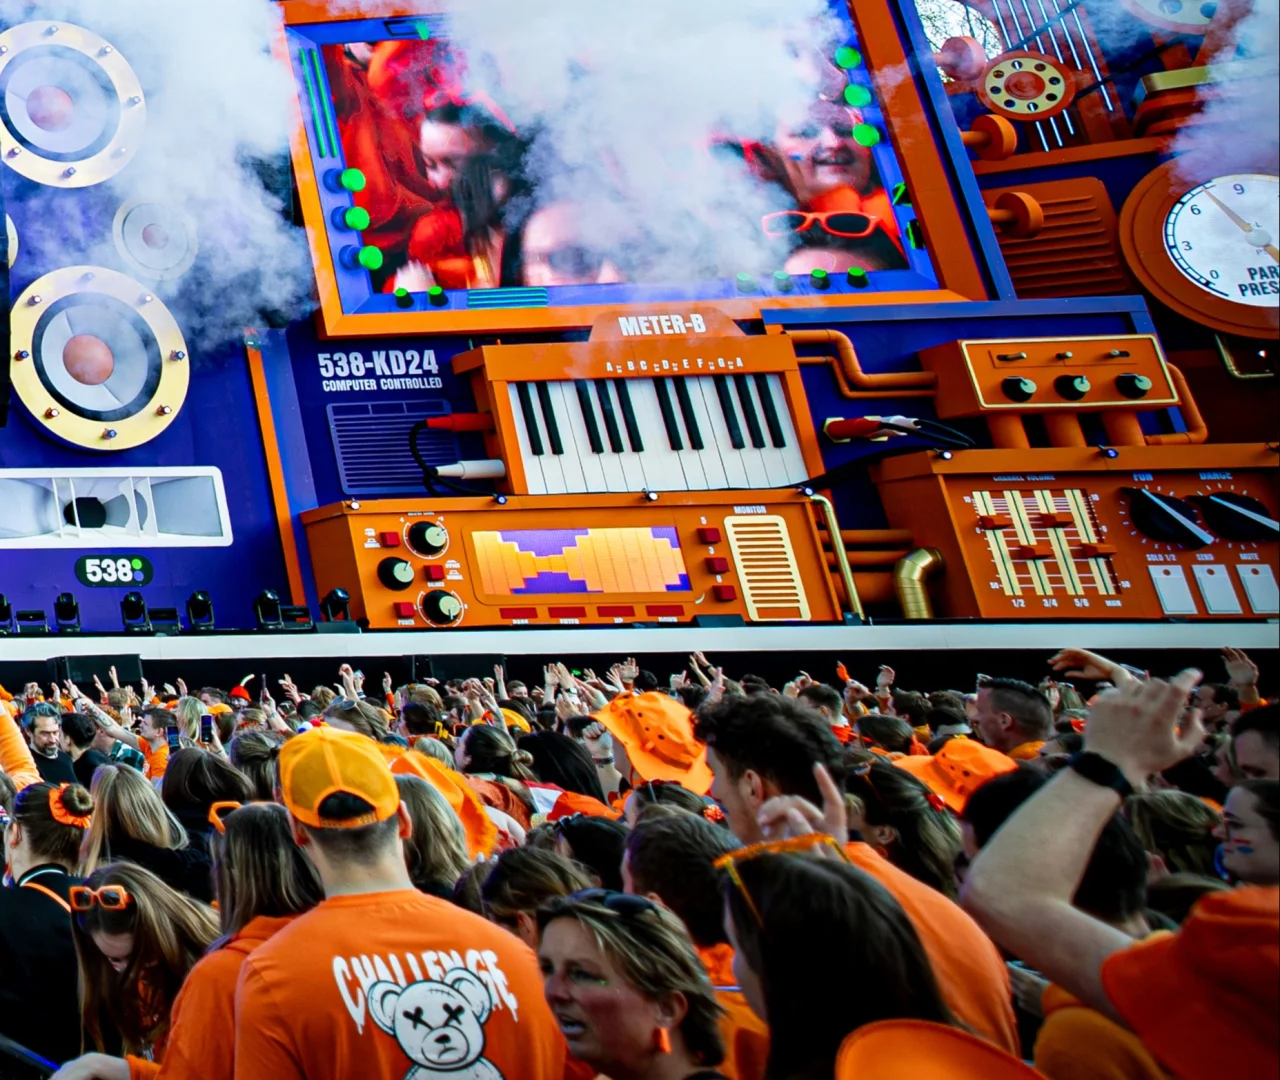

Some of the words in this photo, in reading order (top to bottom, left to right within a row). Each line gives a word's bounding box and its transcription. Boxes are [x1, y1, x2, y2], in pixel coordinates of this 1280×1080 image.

[1233, 183, 1245, 195] 9
[1190, 204, 1202, 216] 6
[1181, 240, 1193, 252] 3
[1209, 269, 1220, 280] 0
[1247, 265, 1279, 281] PAR
[618, 313, 707, 336] METER-B
[318, 349, 439, 378] 538-KD24
[606, 362, 613, 372] A
[627, 361, 635, 371] B
[640, 360, 648, 370] C
[682, 359, 690, 369] E
[697, 358, 703, 368] F
[736, 357, 744, 367] A
[322, 379, 377, 392] COMPUTER
[380, 377, 442, 390] CONTROLLED
[733, 505, 767, 515] MONITOR
[85, 558, 133, 582] 538
[1011, 598, 1026, 607] 1/2
[1042, 598, 1058, 607] 3/4
[332, 949, 518, 1035] CHALLENGE
